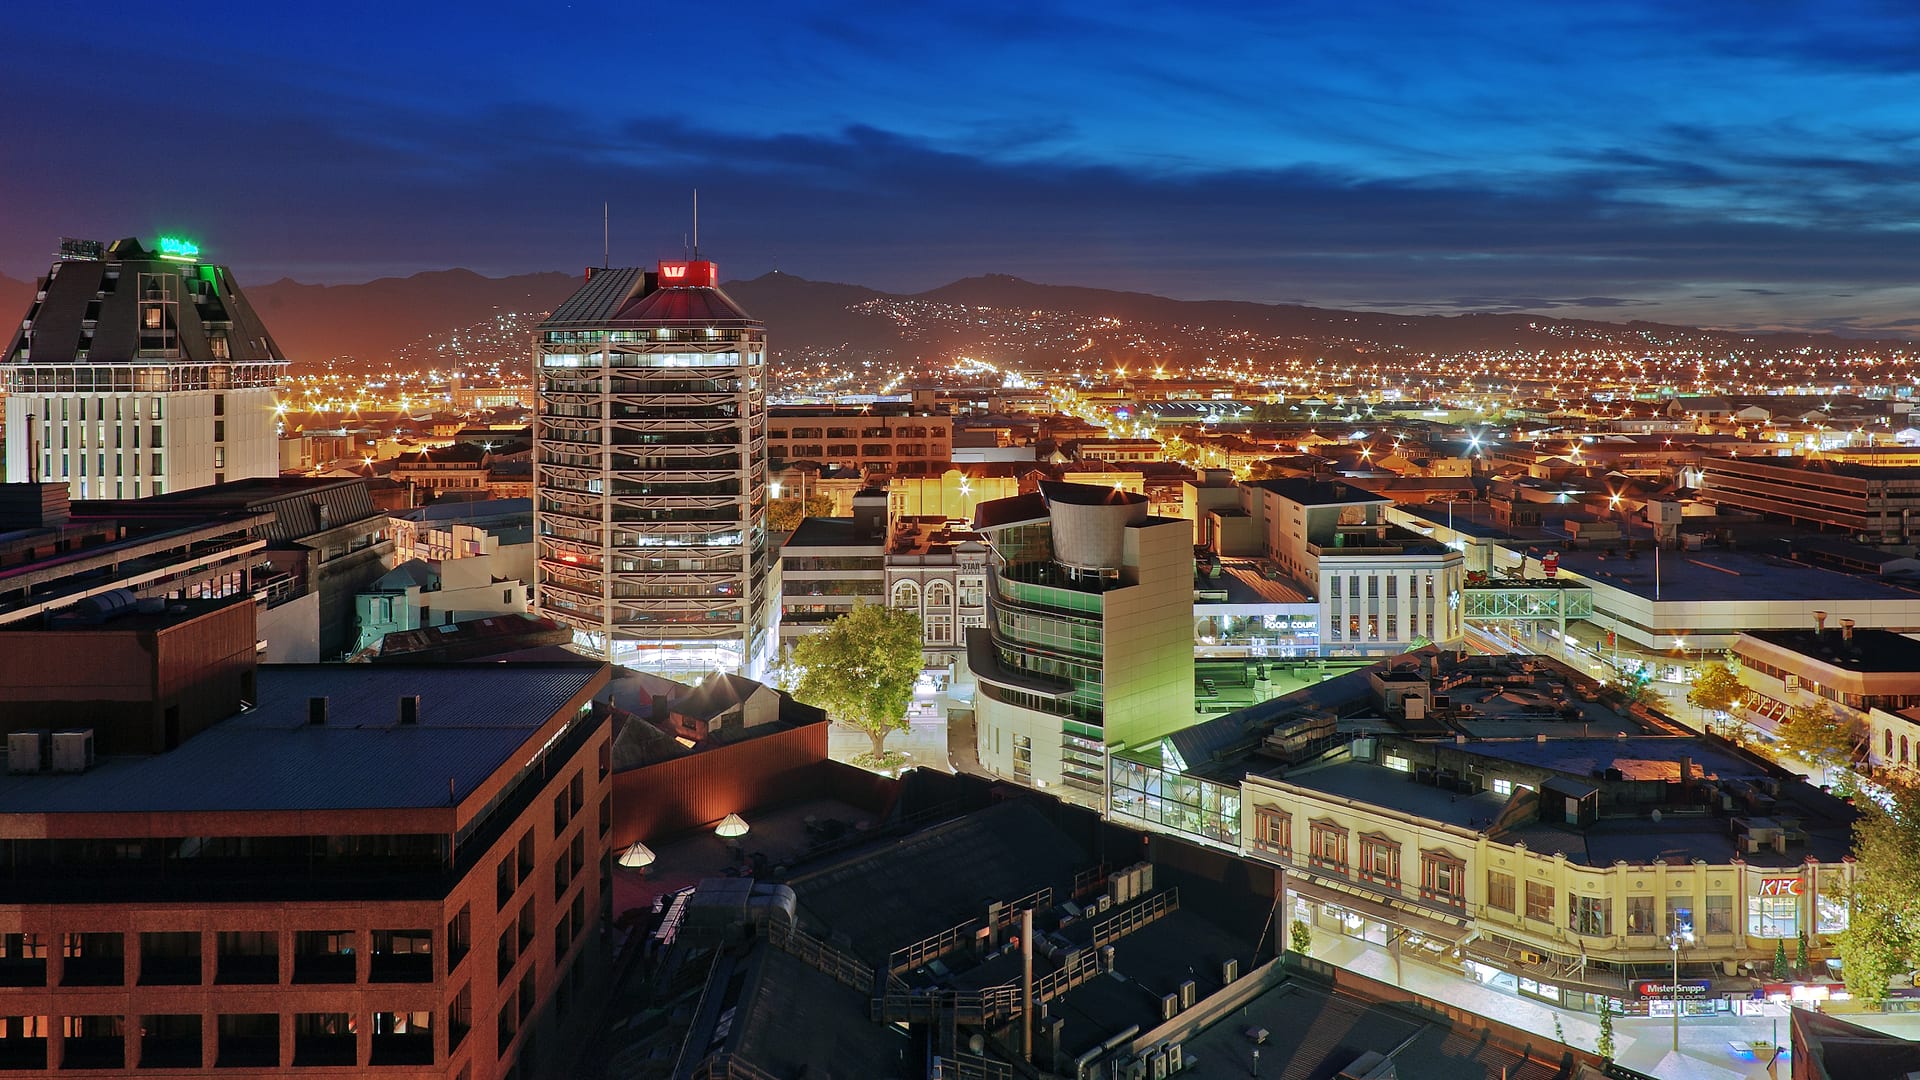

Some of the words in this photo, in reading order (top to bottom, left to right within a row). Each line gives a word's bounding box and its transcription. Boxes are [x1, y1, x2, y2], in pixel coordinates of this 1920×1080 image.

[1264, 621, 1289, 629] FOOD
[1290, 621, 1318, 629] COURT
[1758, 878, 1805, 896] KFC
[1676, 982, 1706, 995] Snipps
